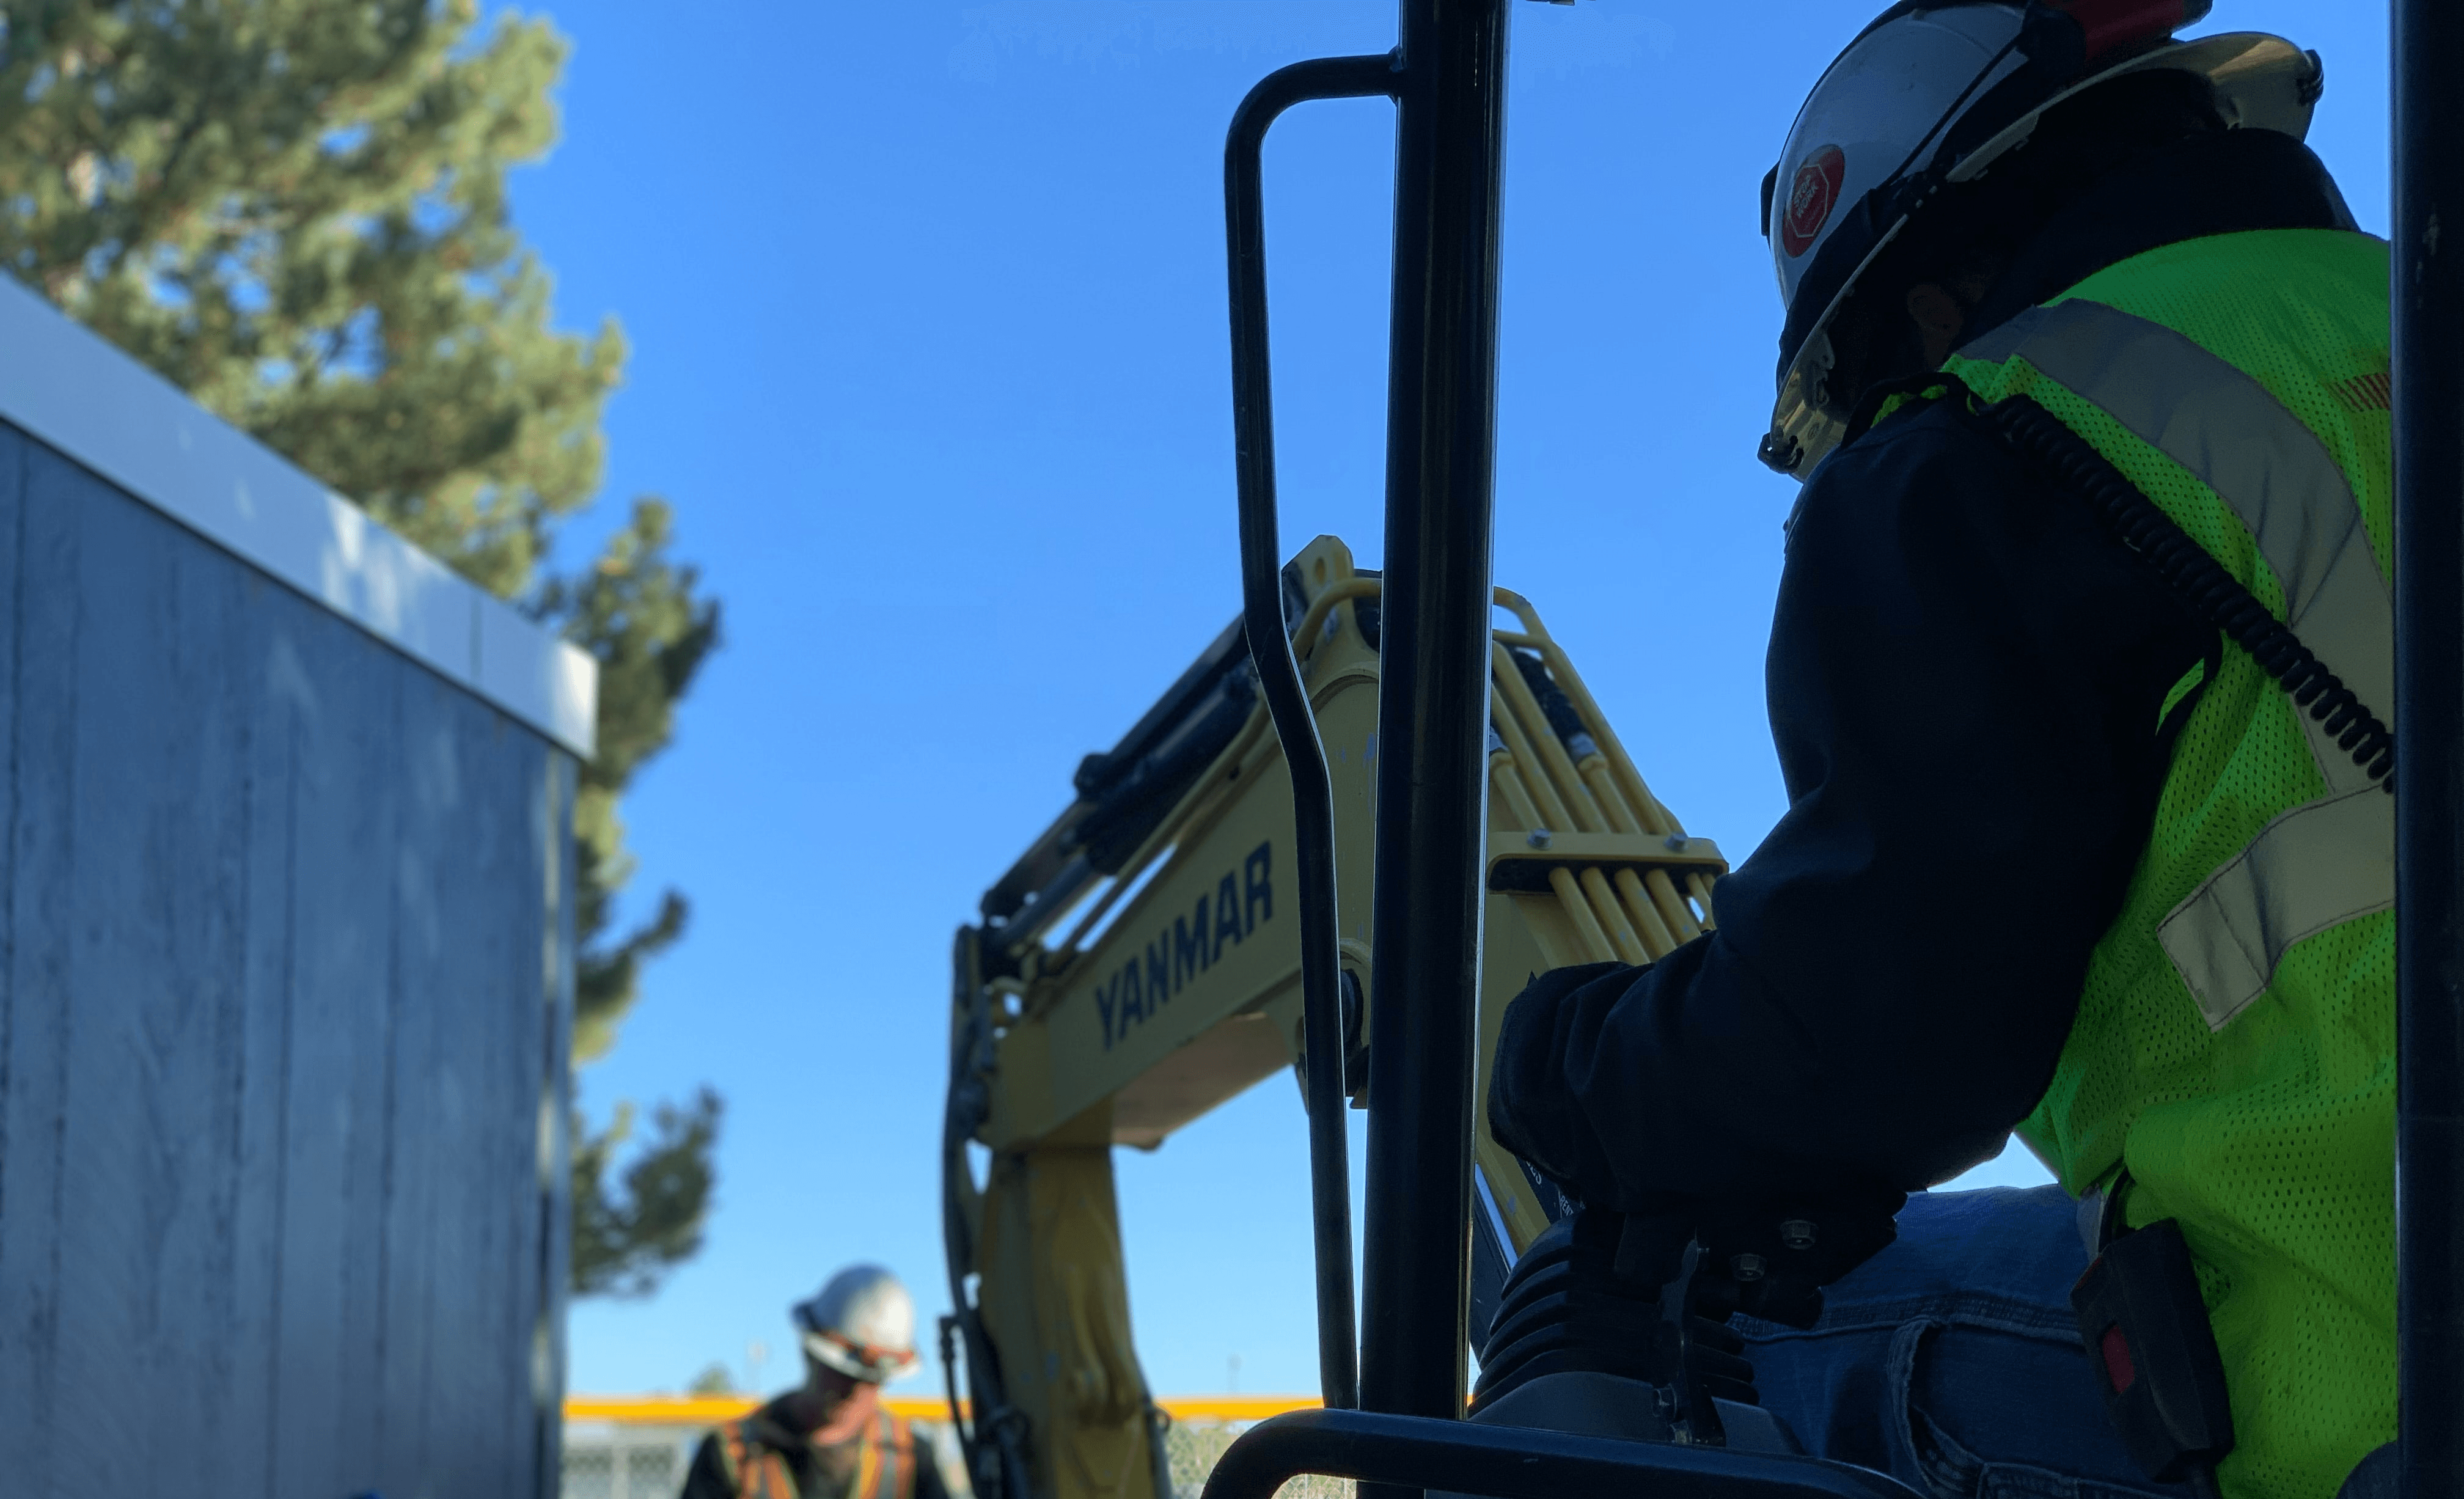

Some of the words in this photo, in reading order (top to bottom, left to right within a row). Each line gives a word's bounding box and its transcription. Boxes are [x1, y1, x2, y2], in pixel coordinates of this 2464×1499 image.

[1793, 174, 1811, 209] STOP
[1796, 181, 1819, 219] WORK
[1095, 838, 1272, 1052] YANMAR
